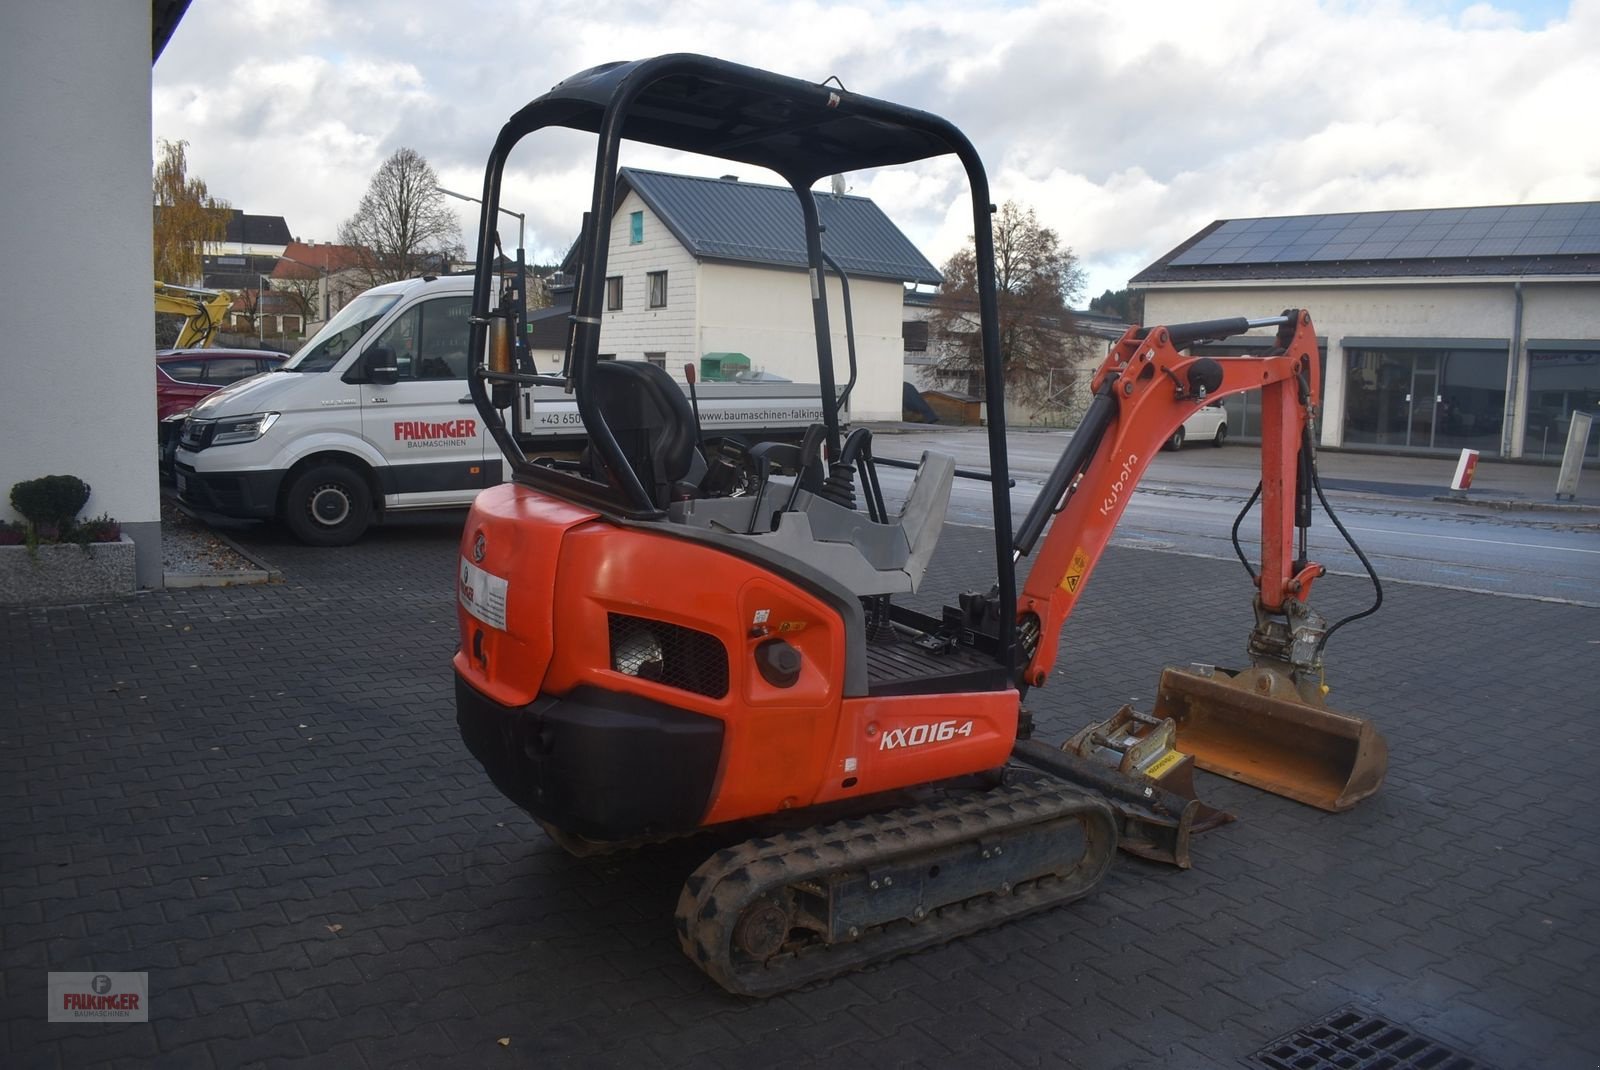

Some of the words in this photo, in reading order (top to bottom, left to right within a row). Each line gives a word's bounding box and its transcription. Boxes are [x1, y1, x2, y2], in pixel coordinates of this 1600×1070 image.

[540, 414, 560, 424] +43
[562, 413, 581, 424] 650
[394, 420, 476, 440] FALKINGER
[407, 440, 467, 449] BAUMASCHINEN
[1100, 454, 1138, 516] Kubota
[880, 720, 973, 750] KX016-4
